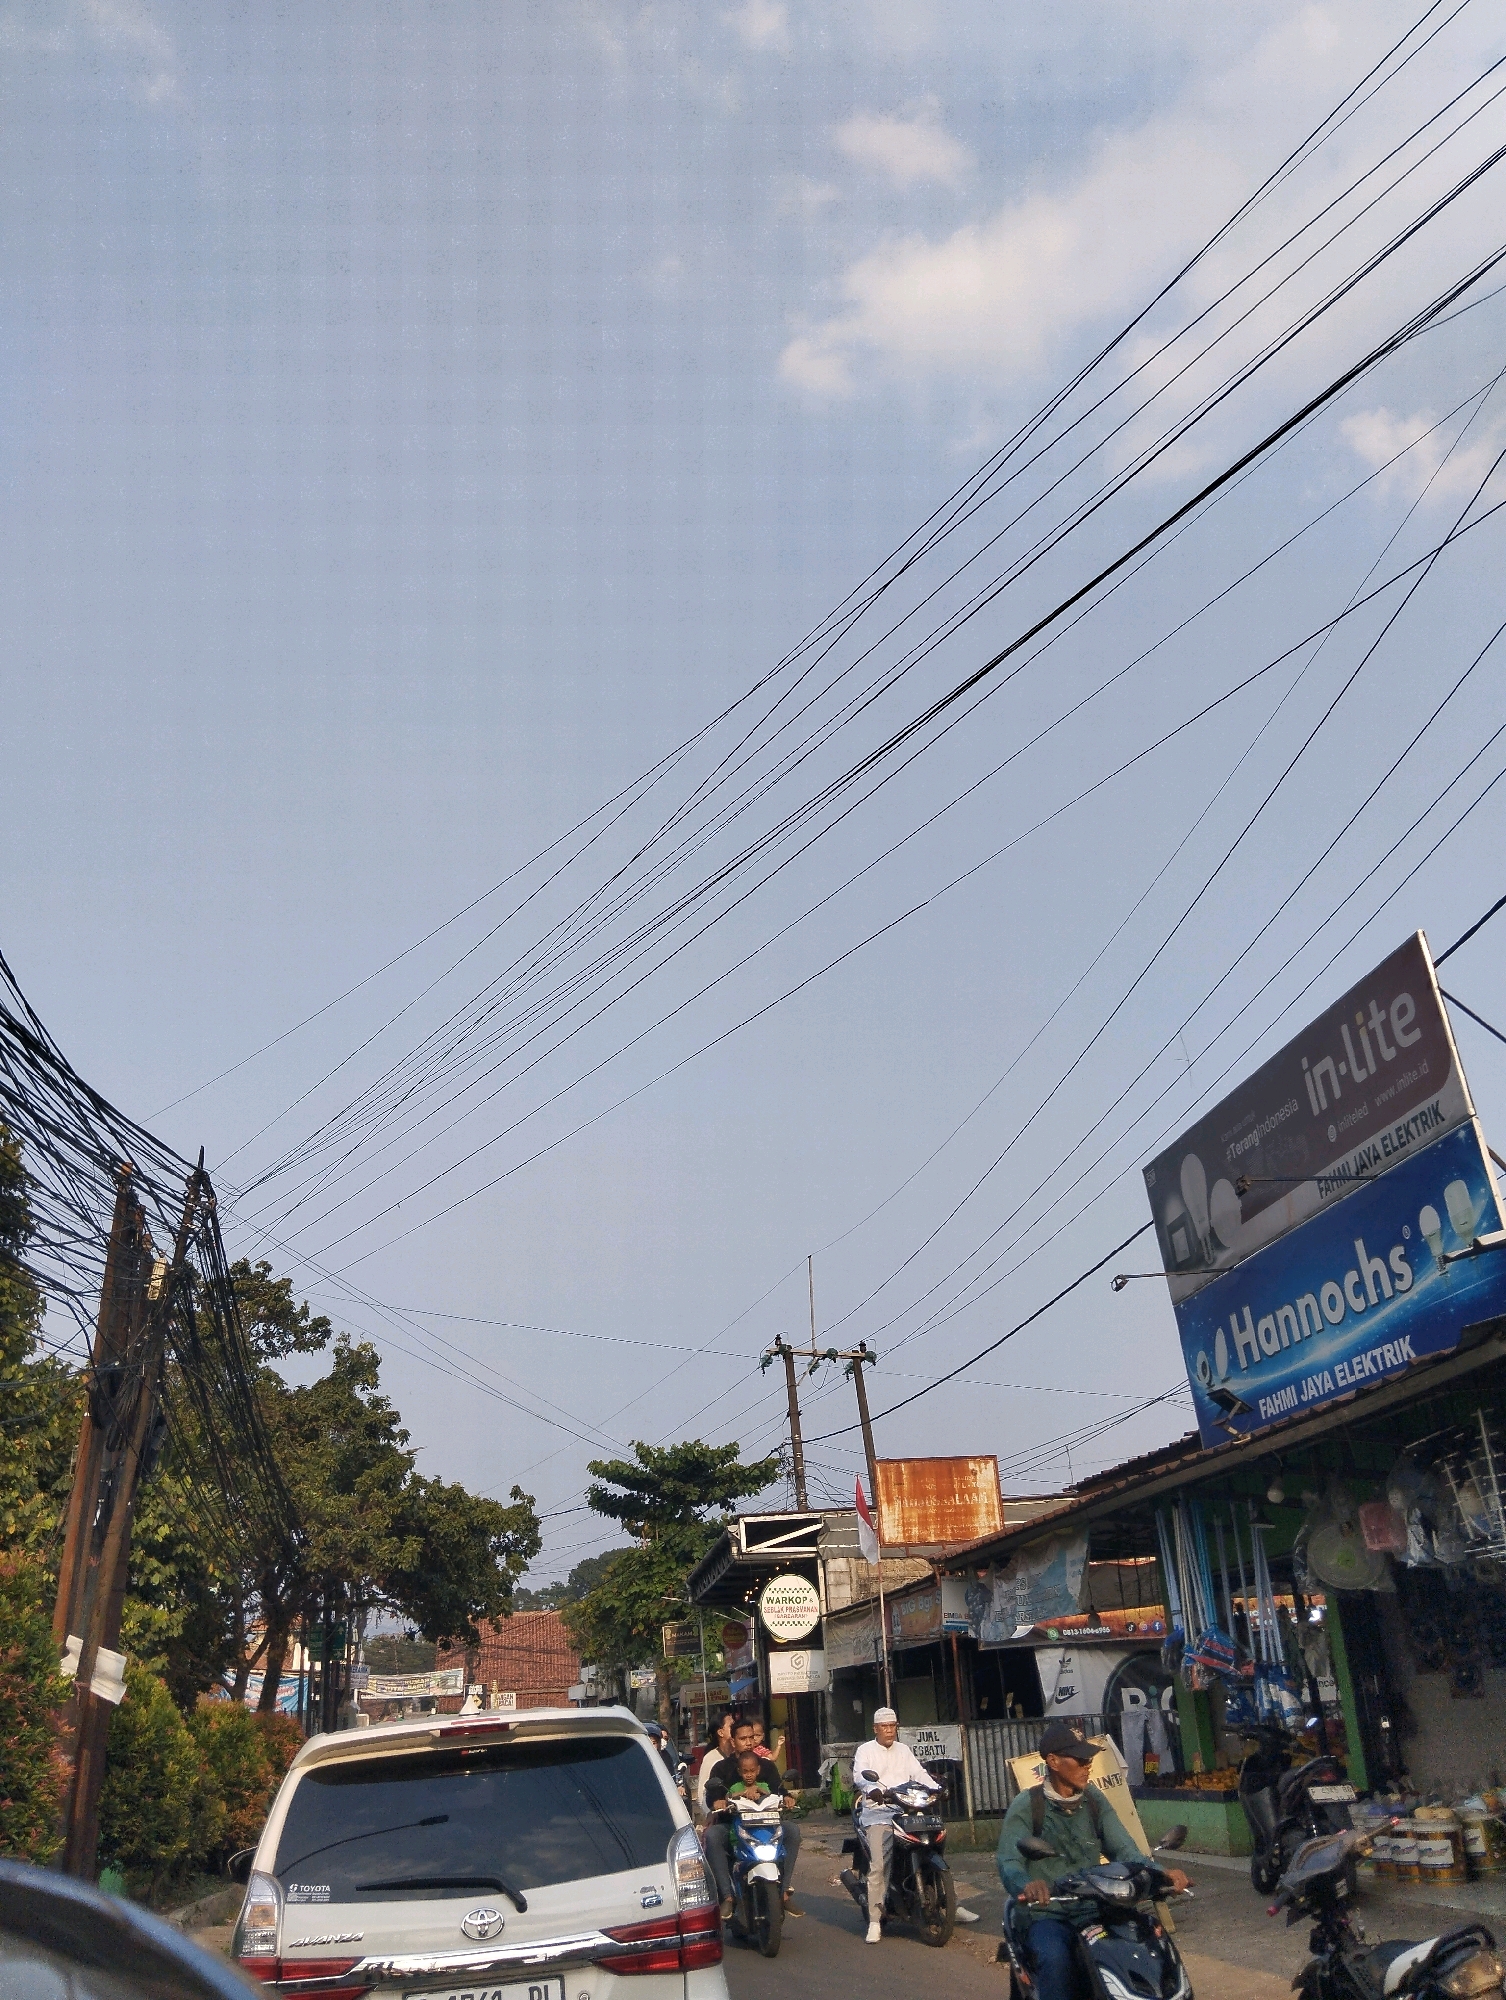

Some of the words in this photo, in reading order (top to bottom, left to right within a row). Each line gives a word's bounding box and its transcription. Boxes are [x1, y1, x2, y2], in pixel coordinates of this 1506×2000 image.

[1226, 1098, 1299, 1161] #TerangIndonesia
[1316, 1166, 1351, 1200] FAHMI
[1352, 1143, 1382, 1177] JAYA
[1380, 1099, 1446, 1158] ELEKTRIK
[1228, 1238, 1414, 1371] Hannochs
[1258, 1384, 1299, 1420] FAHMI
[1301, 1371, 1335, 1402] JAYA
[1333, 1335, 1417, 1388] ELEKTRIK
[766, 1596, 808, 1605] WARKOP
[1058, 1685, 1076, 1697] NIKE
[917, 1731, 940, 1742] JUAL
[300, 1884, 331, 1892] TOYOTA
[288, 1931, 365, 1948] AVANZA
